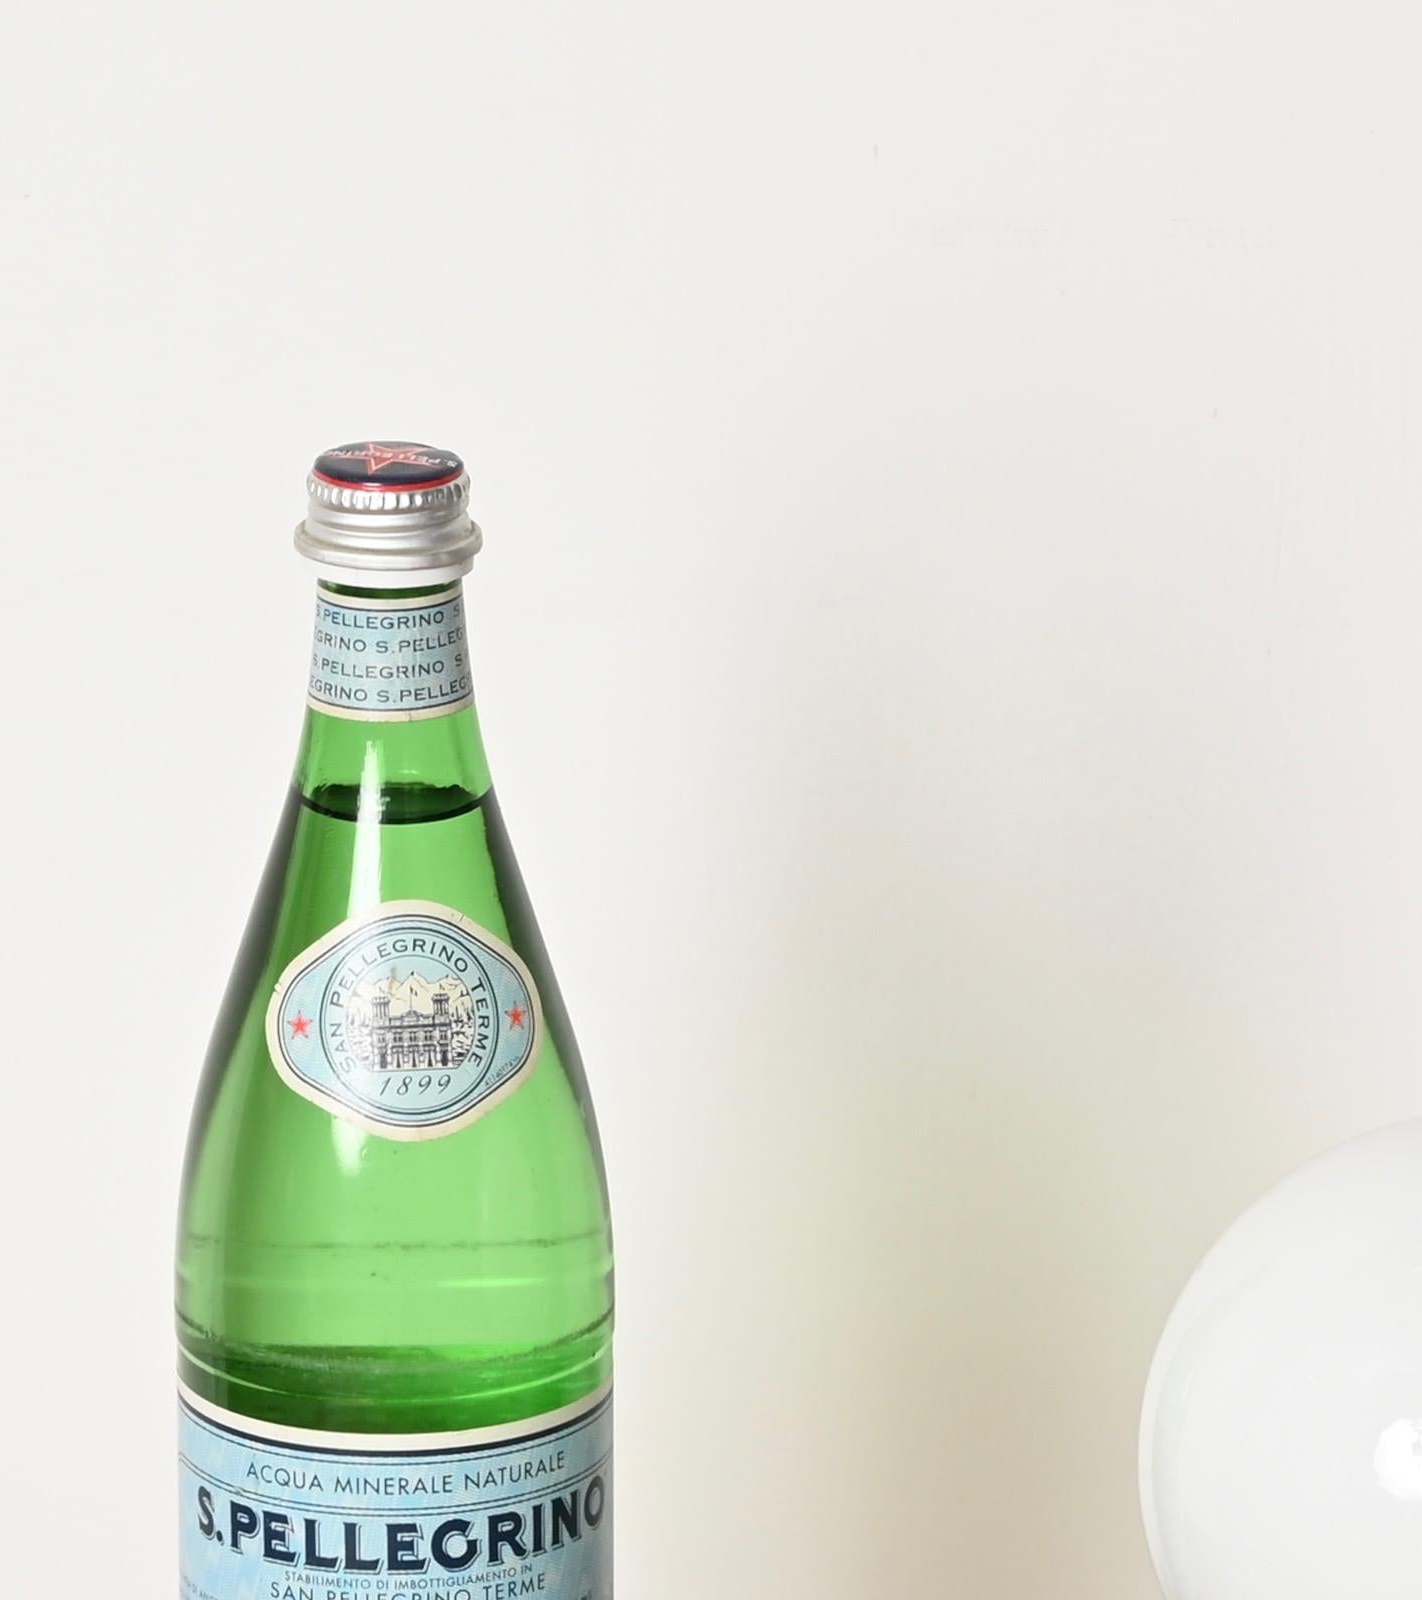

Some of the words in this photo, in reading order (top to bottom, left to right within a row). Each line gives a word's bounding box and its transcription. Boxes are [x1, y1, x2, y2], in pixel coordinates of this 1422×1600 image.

[329, 937, 469, 1008] PELLEGRINO
[329, 1022, 356, 1074] SAN
[467, 976, 491, 1068] TERME
[379, 1073, 452, 1096] 1899
[246, 1461, 324, 1492] ACQUA
[334, 1474, 453, 1496] MINERALE
[464, 1450, 565, 1491] NATURALE
[197, 1474, 606, 1576] S.PELLEGRINO
[284, 1570, 372, 1590] STABILIMENTO
[377, 1579, 390, 1590] DI
[394, 1569, 518, 1590] IMBOTTIGLIAMENTO
[520, 1563, 533, 1574] IN
